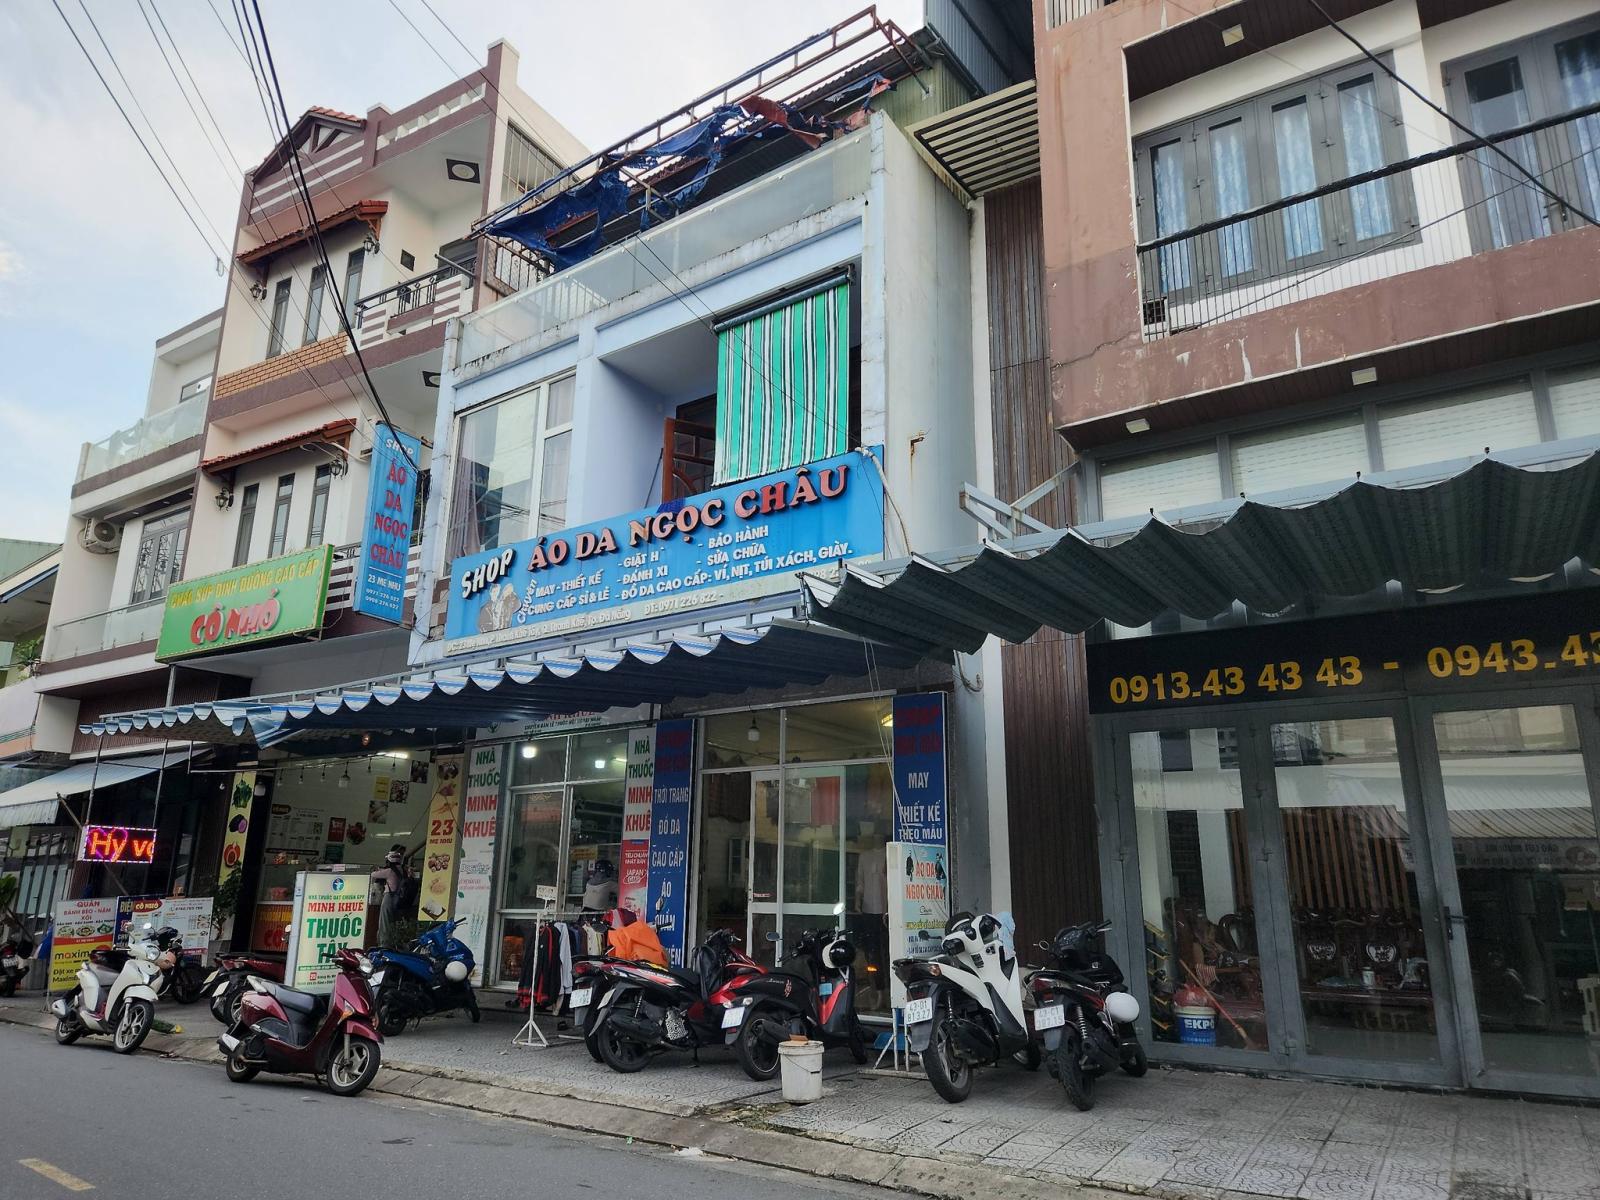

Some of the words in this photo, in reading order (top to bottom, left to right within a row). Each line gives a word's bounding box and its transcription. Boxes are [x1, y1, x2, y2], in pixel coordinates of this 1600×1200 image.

[384, 489, 402, 512] DA
[374, 512, 408, 541] NGỌC
[461, 548, 516, 599] SHOP
[527, 535, 570, 572] ÁO
[574, 526, 617, 560] DA
[629, 498, 727, 547] NGỌC
[733, 464, 852, 520] CHÂU
[708, 533, 733, 549] BẢO
[735, 525, 769, 542] HÀNH
[370, 543, 404, 569] CHÂU
[535, 584, 557, 598] MAY
[561, 573, 587, 592] THIẾT
[588, 568, 604, 586] KẾ
[622, 569, 653, 585] ĐÁNH
[656, 565, 669, 577] XI
[639, 584, 655, 597] DA
[656, 577, 682, 592] CAO
[754, 555, 773, 571] TÚI
[526, 603, 555, 616] CUNG
[556, 592, 578, 611] CẤP
[1257, 661, 1304, 692] 43
[1316, 655, 1363, 687] 43
[475, 747, 496, 766] NHÀ
[634, 738, 650, 755] NHÀ
[467, 768, 501, 789] THUỐC
[628, 758, 654, 779] THUỐC
[908, 772, 930, 789] MAY
[466, 795, 497, 812] MINH
[627, 786, 652, 804] MINH
[668, 787, 689, 803] TRANG
[927, 799, 941, 822] KẾ
[430, 819, 454, 836] 23
[463, 818, 497, 838] KHUÊ
[670, 819, 681, 835] DA
[898, 828, 920, 840] THEO
[90, 831, 127, 862] Hy
[652, 850, 667, 867] CAO
[661, 878, 672, 898] ÁO
[308, 902, 335, 913] MINH
[306, 913, 362, 938] THUỐC
[55, 950, 89, 960] maxim
